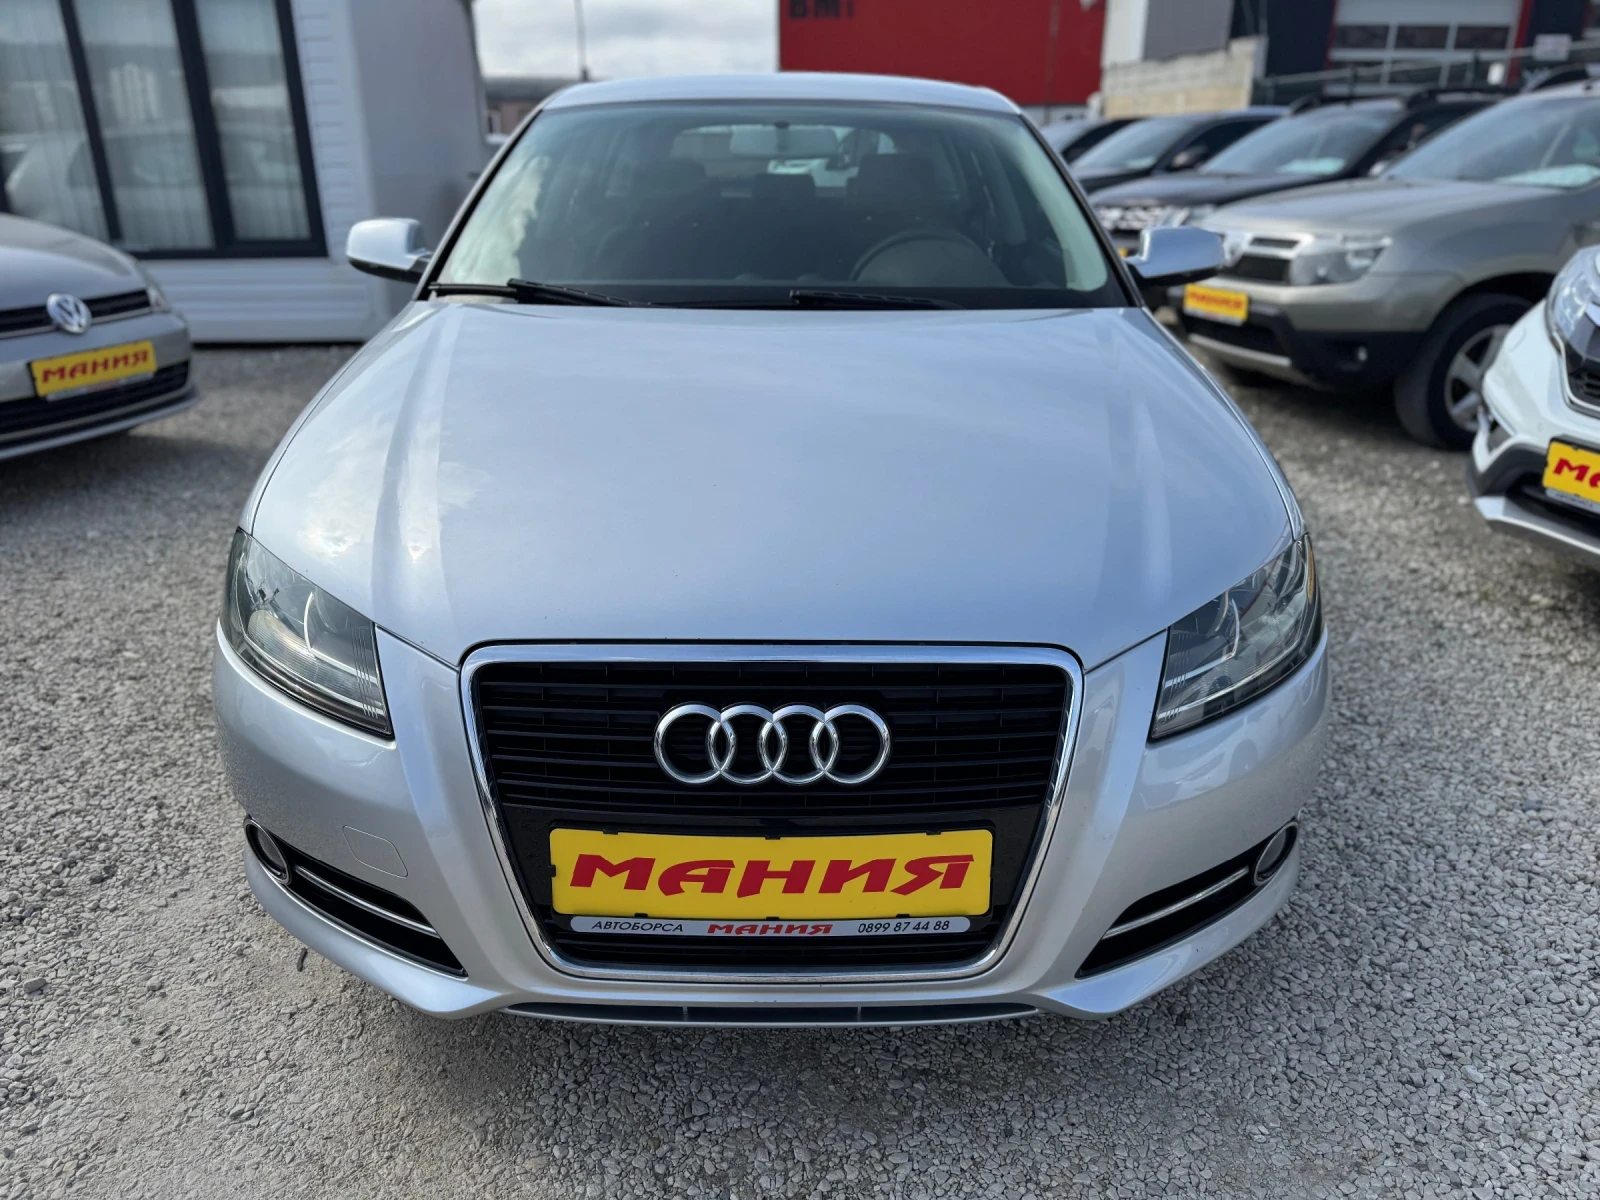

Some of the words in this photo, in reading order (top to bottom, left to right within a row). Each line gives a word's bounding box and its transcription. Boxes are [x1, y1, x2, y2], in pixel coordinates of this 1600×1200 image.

[570, 854, 974, 898] МАНИЯ
[591, 921, 684, 932] АВТОБОРСА
[706, 924, 833, 935] МАНИЯ
[858, 923, 890, 933] 0899
[893, 922, 911, 932] 87
[912, 921, 930, 931] 44
[933, 920, 950, 930] 88
